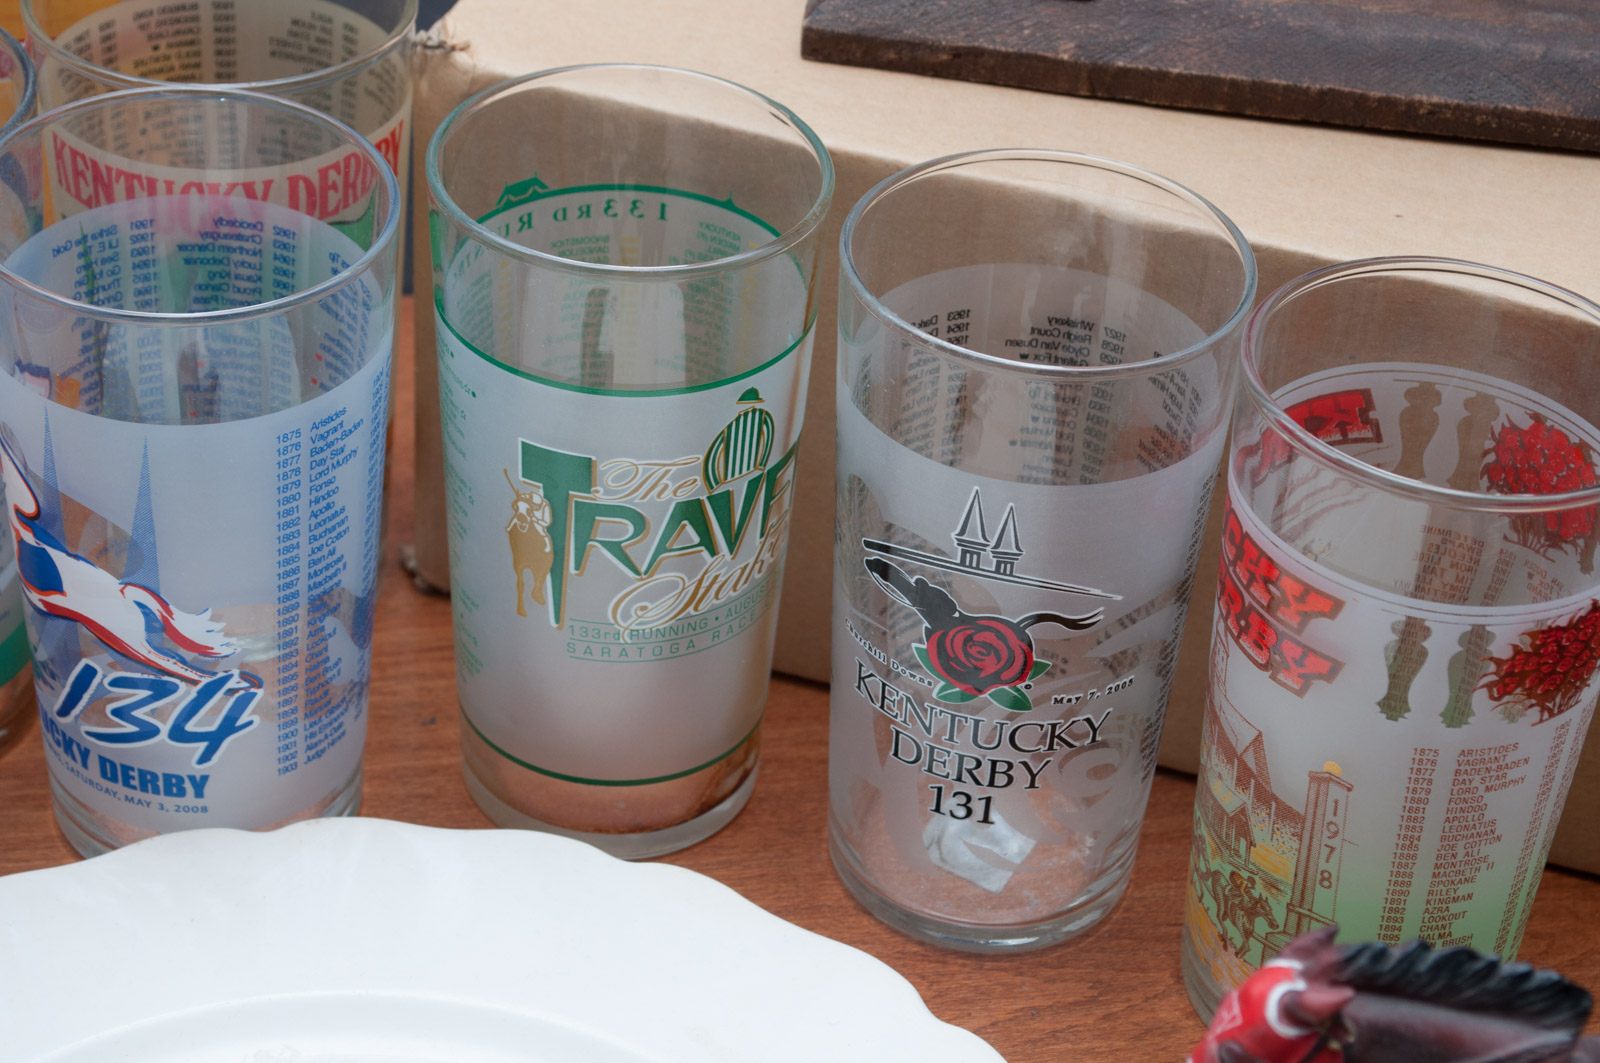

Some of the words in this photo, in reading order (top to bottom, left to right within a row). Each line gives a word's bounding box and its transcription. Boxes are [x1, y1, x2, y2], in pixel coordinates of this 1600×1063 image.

[276, 429, 301, 444] 1875
[310, 407, 347, 432] Aristides
[276, 442, 301, 457] 1876
[310, 421, 344, 444] Vagrant
[276, 455, 301, 469] 1877
[276, 468, 301, 482] 1878
[310, 456, 327, 470] Day
[330, 444, 346, 461] Star
[276, 480, 301, 495] 1879
[309, 467, 330, 483] Lord
[591, 456, 702, 501] The
[276, 493, 301, 507] 1880
[309, 475, 336, 495] Fonso
[276, 506, 301, 520] 1881
[308, 486, 339, 508] Hindoo
[276, 518, 301, 532] 1882
[308, 500, 335, 521] Apollo
[276, 531, 301, 545] 1883
[519, 437, 798, 630] TRAVE
[276, 544, 301, 557] 1884
[276, 556, 301, 569] 1885
[308, 542, 324, 557] Joe
[276, 568, 301, 581] 1886
[308, 556, 323, 569] Ben
[277, 580, 299, 593] 1887
[277, 591, 299, 604] 1888
[277, 603, 299, 616] 1889
[277, 615, 299, 628] 1890
[277, 627, 299, 640] 1891
[567, 639, 696, 658] SARATOGA
[712, 610, 756, 642] RACE
[568, 625, 621, 641] 133rd
[630, 617, 708, 641] RUNNING
[277, 639, 299, 652] 1892
[277, 650, 299, 663] 1893
[277, 662, 299, 675] 1894
[890, 658, 933, 688] Downs
[278, 674, 298, 687] 1895
[278, 685, 298, 697] 1896
[1052, 693, 1081, 706] May
[1106, 676, 1135, 696] 2005
[278, 696, 298, 709] 1897
[854, 658, 1113, 754] KENTUCKY
[54, 659, 264, 767] 134
[278, 708, 298, 720] 1898
[278, 719, 298, 731] 1899
[278, 730, 298, 742] 1900
[278, 741, 298, 754] 1901
[1413, 748, 1439, 757] 1875
[1458, 743, 1519, 757] ARISTIDES
[278, 752, 298, 765] 1902
[891, 725, 1051, 790] DERBY
[1411, 757, 1437, 767] 1876
[1457, 754, 1508, 767] VAGRANT
[278, 764, 298, 776] 1903
[1409, 767, 1435, 776] 1877
[1454, 757, 1530, 777] BADEN-BADEN
[97, 754, 210, 799] DERBY
[1407, 777, 1433, 786] 1878
[1452, 778, 1475, 787] DAY
[1480, 773, 1507, 785] STAR
[1405, 786, 1431, 795] 1879
[1450, 787, 1479, 796] LORD
[1484, 775, 1527, 793] MURPHY
[124, 794, 152, 809] MAY
[158, 803, 170, 813] 3,
[174, 805, 208, 814] 2008
[929, 785, 995, 824] 131
[1403, 796, 1429, 805] 1880
[1448, 796, 1484, 805] FONSO
[1401, 805, 1426, 814] 1881
[1446, 804, 1488, 815] HINDOO
[1400, 815, 1425, 824] 1882
[1444, 813, 1484, 824] APOLLO
[1398, 824, 1423, 833] 1883
[1442, 819, 1496, 833] LEONATUS
[1396, 834, 1421, 843] 1884
[1440, 828, 1496, 843] BUCHANAN
[1318, 798, 1340, 890] 1978
[1395, 843, 1419, 852] 1885
[1437, 844, 1458, 852] JOE
[1464, 835, 1502, 850] COTTON
[1392, 852, 1417, 861] 1886
[1436, 852, 1458, 861] BEN
[1463, 849, 1480, 858] ALI
[1391, 861, 1416, 870] 1887
[1434, 855, 1489, 871] MONTROSE
[1389, 870, 1414, 879] 1888
[1432, 866, 1481, 879] MACBETH
[1387, 880, 1412, 888] 1889
[1429, 876, 1477, 888] SPOKANE
[1385, 888, 1410, 897] 1890
[1428, 887, 1459, 897] RILEY
[1384, 897, 1407, 906] 1891
[1425, 893, 1473, 906] KINGMAN
[1380, 915, 1404, 924] 1893
[1422, 911, 1467, 924] LOOKOUT
[1382, 906, 1406, 915] 1892
[1423, 906, 1450, 915] AZRA
[1378, 924, 1402, 933] 1894
[1419, 923, 1454, 933] CHANT
[1377, 933, 1400, 941] 1895
[1419, 931, 1452, 941] HALMA
